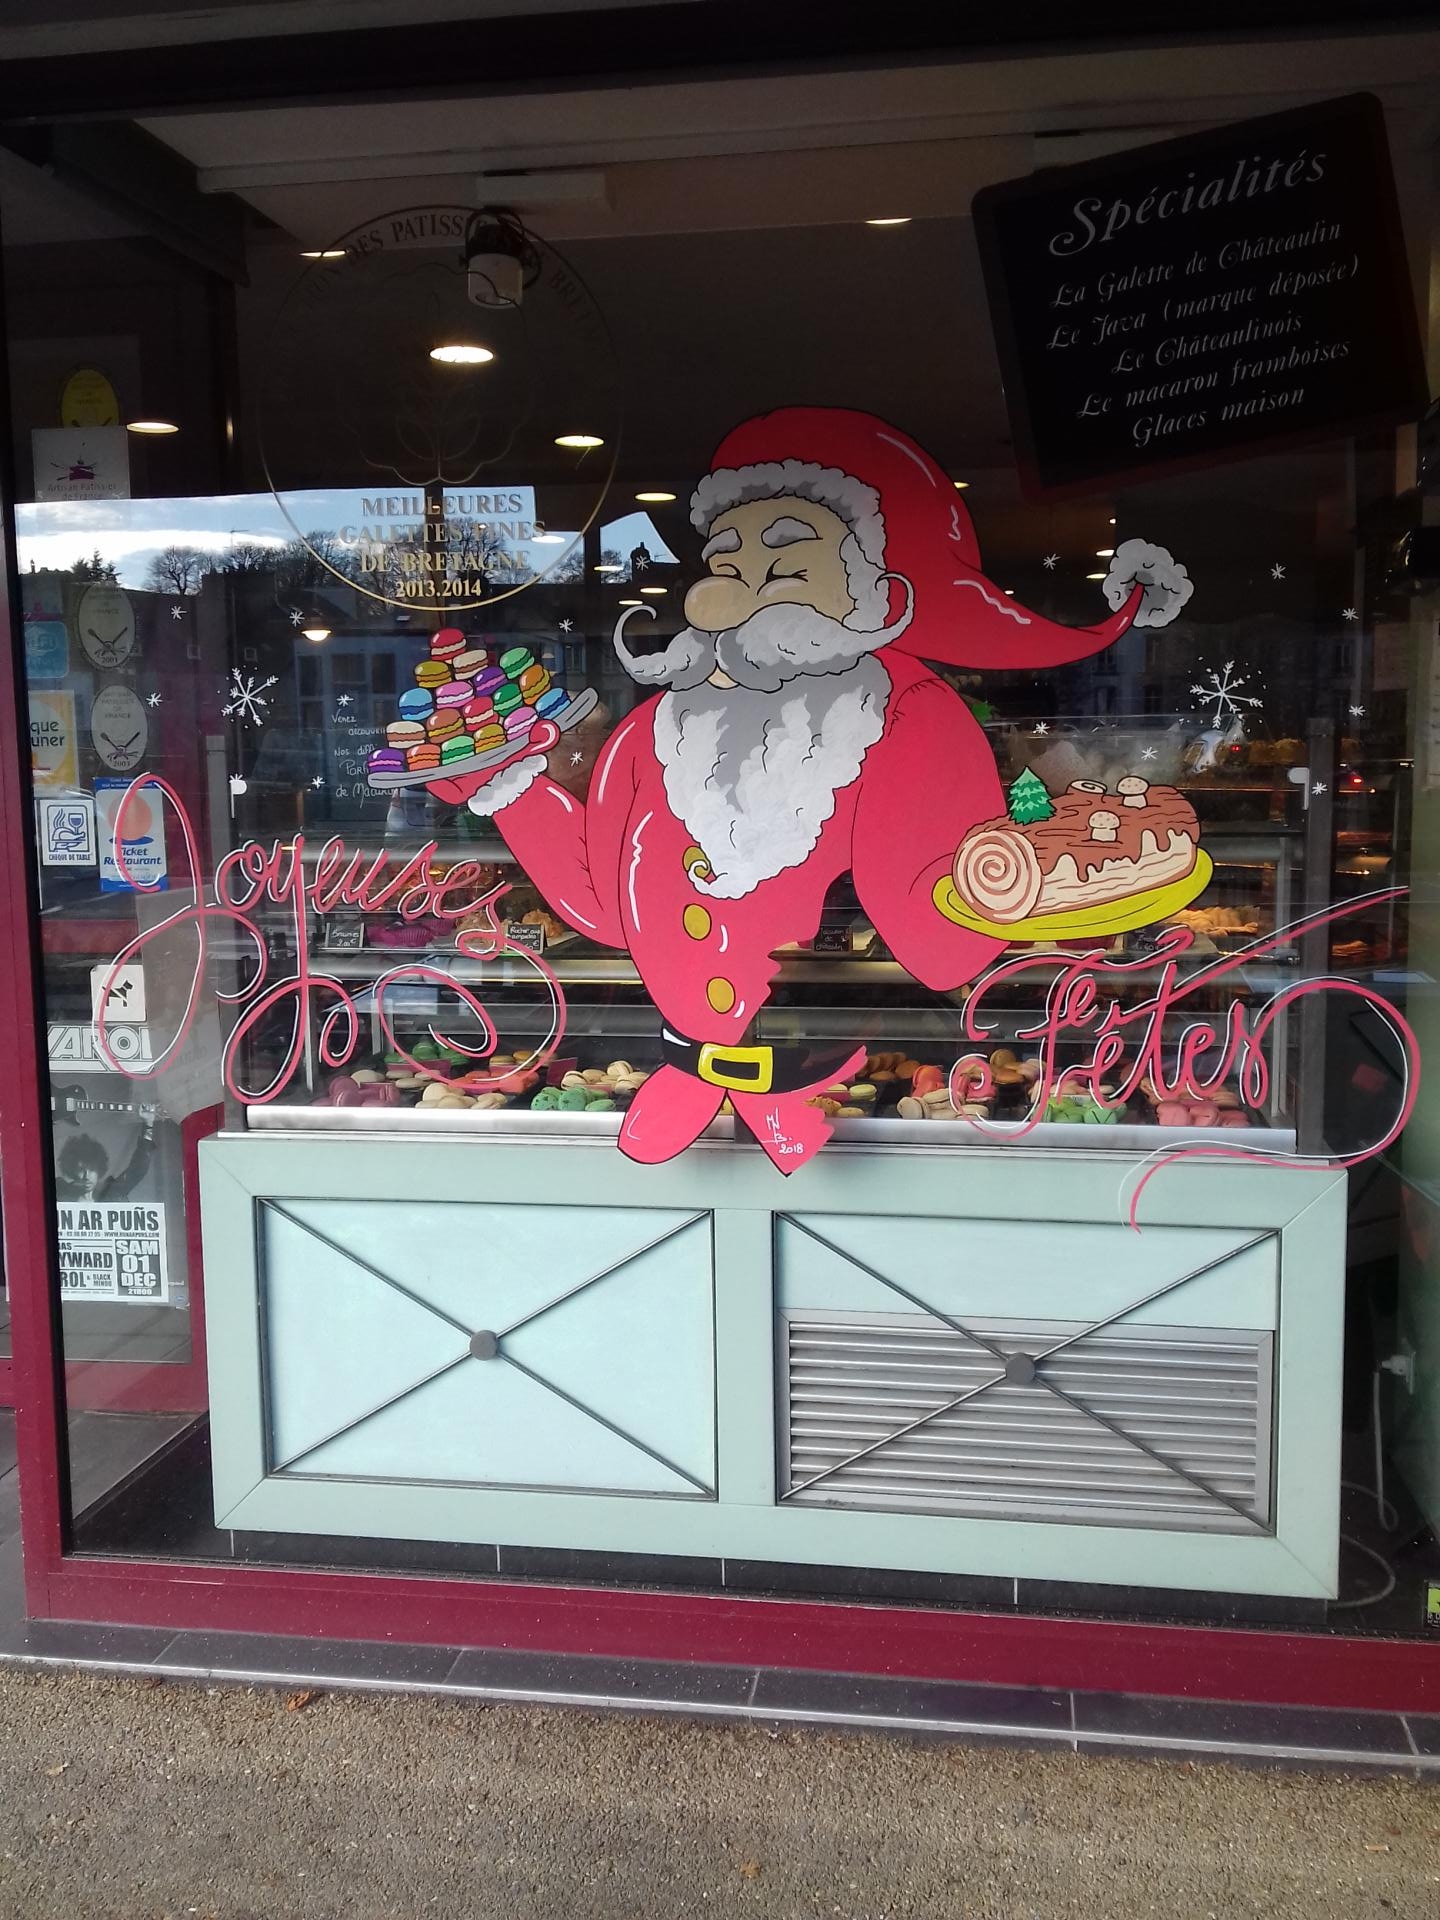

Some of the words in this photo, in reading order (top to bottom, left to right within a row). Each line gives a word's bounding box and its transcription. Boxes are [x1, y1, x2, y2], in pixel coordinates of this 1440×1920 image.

[1048, 148, 1328, 257] Spécialités
[1049, 280, 1086, 308] La
[1097, 263, 1174, 304] Galette
[1185, 250, 1207, 276] de
[1218, 218, 1342, 271] Châteaulin
[1046, 323, 1081, 351] Le
[1163, 287, 1257, 323] (marque
[1269, 254, 1360, 297] déposée)
[1111, 347, 1145, 375] Le
[1154, 309, 1303, 367] Châteaulinois
[1075, 390, 1112, 419] Le
[1125, 372, 1219, 408] macaron
[1230, 338, 1351, 387] framboises
[1132, 409, 1207, 449] Glaces
[1219, 387, 1305, 422] maison
[361, 492, 523, 517] MEILLEURES
[338, 523, 463, 546] GALETTES
[360, 554, 392, 574] DE
[400, 550, 531, 573] BRETAGNE
[395, 579, 482, 598] 2013.2014
[31, 721, 60, 733] que
[104, 857, 162, 866] Retaurant
[121, 847, 149, 856] icket
[778, 1142, 804, 1155] 2018
[58, 1210, 73, 1230] N
[78, 1210, 103, 1230] AR
[107, 1206, 159, 1231] PUÑS
[58, 1242, 73, 1251] AS
[116, 1240, 159, 1255] SAM
[59, 1252, 113, 1268] YWARD
[122, 1255, 150, 1273] 01
[121, 1273, 157, 1287] DEC
